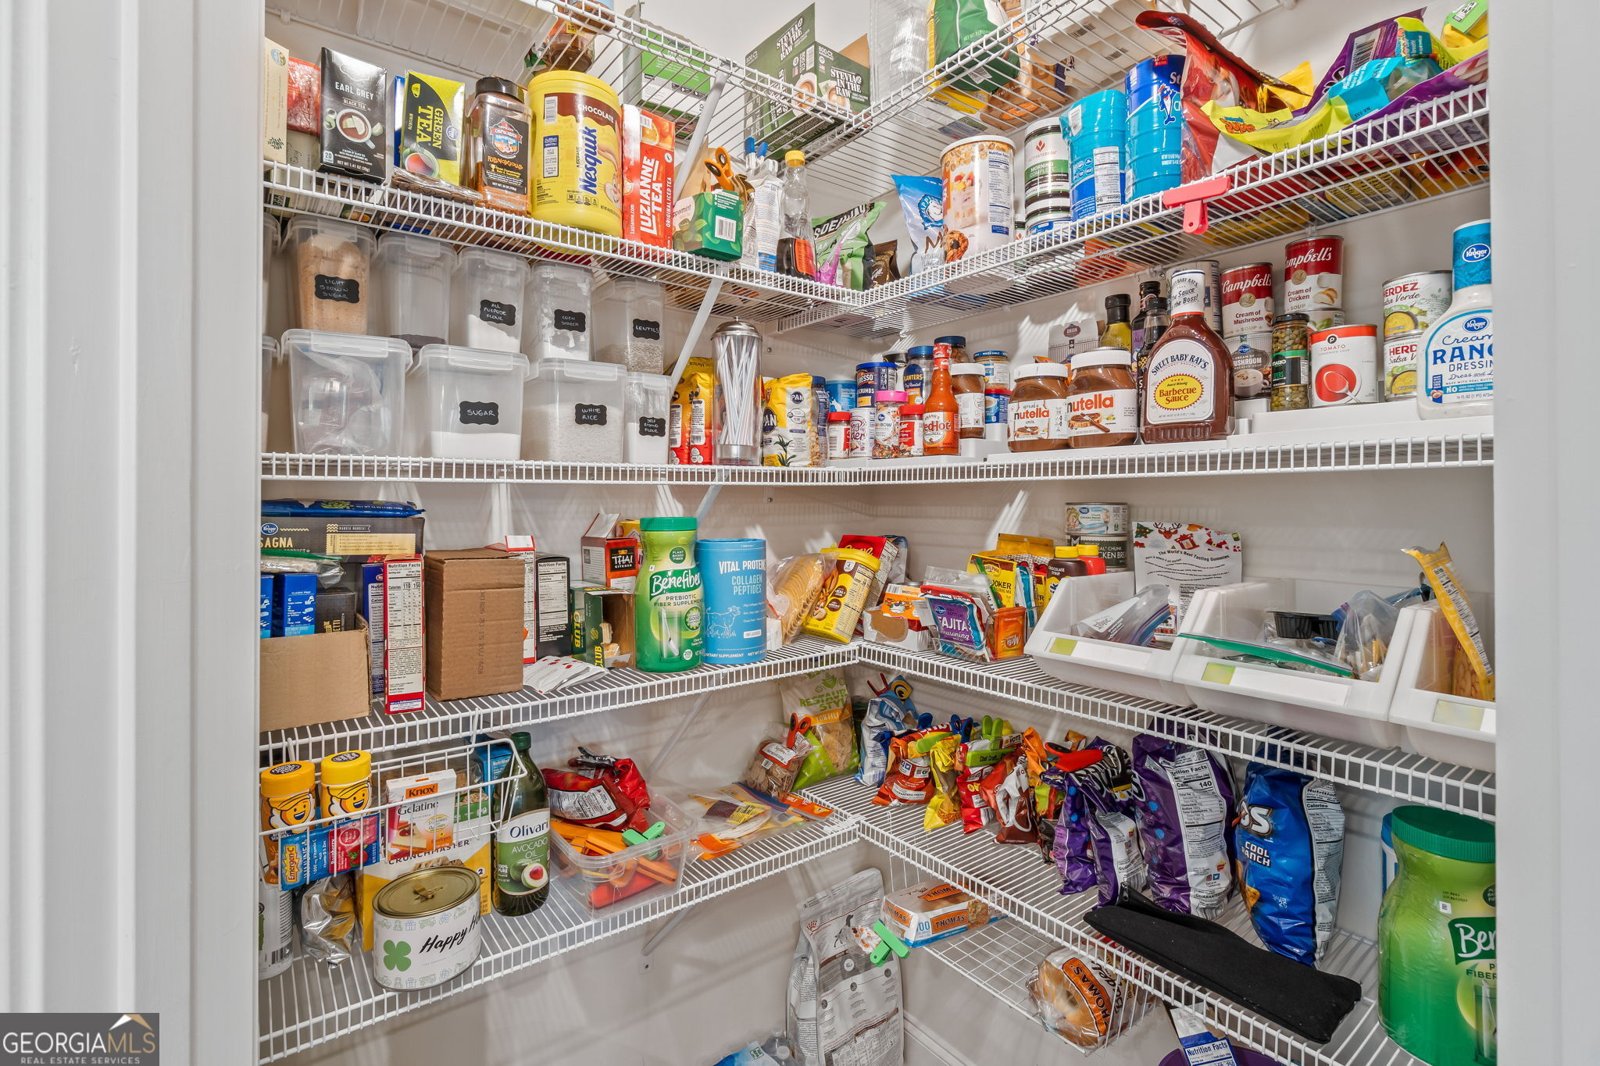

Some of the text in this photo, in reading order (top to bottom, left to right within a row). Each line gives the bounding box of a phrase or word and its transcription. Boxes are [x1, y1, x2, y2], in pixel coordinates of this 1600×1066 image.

[831, 68, 858, 83] STEVIA
[335, 81, 374, 100] EARL GREY
[846, 81, 861, 94] THE
[416, 105, 434, 143] TEA
[432, 107, 444, 149] GREEN
[578, 126, 602, 194] Nesquik
[640, 156, 657, 236] LUZIANNE
[652, 182, 662, 213] TEA
[1286, 247, 1332, 268] ampbell's
[1466, 248, 1488, 261] Kroger
[1222, 273, 1272, 294] Campbell's
[1288, 289, 1304, 297] Cream
[1289, 294, 1310, 303] Chicken
[1395, 293, 1420, 303] Verde
[1233, 316, 1264, 325] Mushroom
[1235, 311, 1254, 319] Cream
[635, 325, 659, 333] LENTILS
[1467, 320, 1487, 332] Kroger
[1442, 334, 1493, 345] Crea
[1320, 344, 1346, 352] TOMATO
[1389, 344, 1418, 356] HERD
[1389, 355, 1407, 365] Salsa
[1432, 344, 1493, 365] RAN
[1151, 353, 1209, 376] SWEET BABY RAY'S
[1233, 357, 1262, 367] USHROOM
[1448, 359, 1493, 373] DRESSI
[1159, 386, 1197, 397] Barbecue
[1067, 393, 1114, 413] nutella
[1166, 395, 1189, 405] Sauce
[466, 409, 495, 417] SUGAR
[1014, 408, 1050, 420] nutella
[763, 413, 777, 428] AN
[923, 420, 951, 432] edHot
[260, 537, 293, 548] SAGNA
[611, 555, 633, 565] THAI
[719, 559, 766, 574] VITAL PROTEI
[731, 574, 762, 587] COLLAGEN
[992, 580, 1012, 590] OKER
[733, 584, 762, 596] PEPTIDES
[665, 593, 697, 601] PREBIOTIC
[573, 611, 581, 648] CLUB
[1190, 764, 1207, 773] Facts
[1199, 780, 1212, 788] 140
[408, 786, 435, 798] Knox
[397, 801, 438, 816] Gelatine
[511, 837, 548, 854] AVOCADO
[1245, 841, 1270, 858] COOL
[525, 849, 537, 858] OIL
[926, 885, 957, 897] THOMA
[419, 927, 468, 955] Happy
[1187, 1041, 1228, 1056] Nutrition Facts
